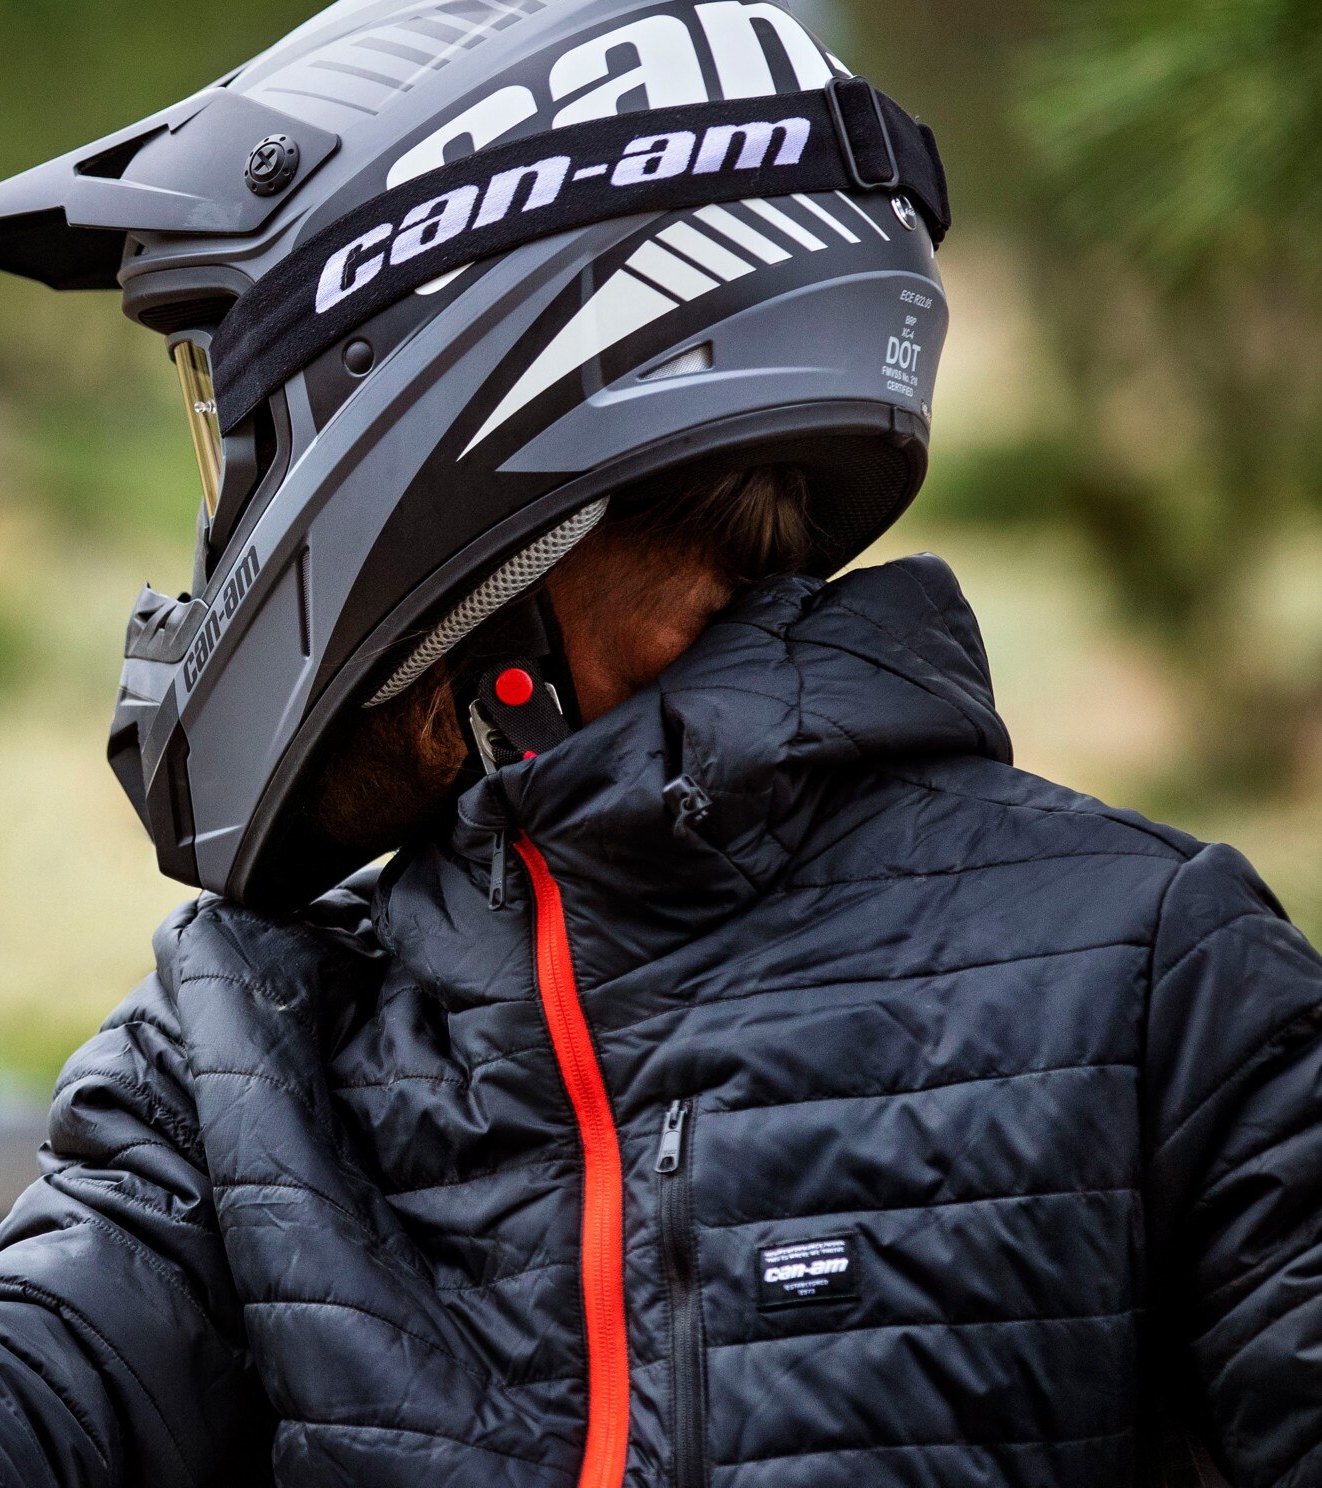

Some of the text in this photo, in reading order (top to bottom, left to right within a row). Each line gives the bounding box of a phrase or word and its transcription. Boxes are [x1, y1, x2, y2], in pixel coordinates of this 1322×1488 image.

[315, 117, 811, 314] can-am
[900, 289, 914, 304] ECE
[885, 336, 921, 371] DOT
[887, 380, 913, 397] CERTIFIED
[183, 545, 260, 693] can-am
[764, 1257, 849, 1283] can-am
